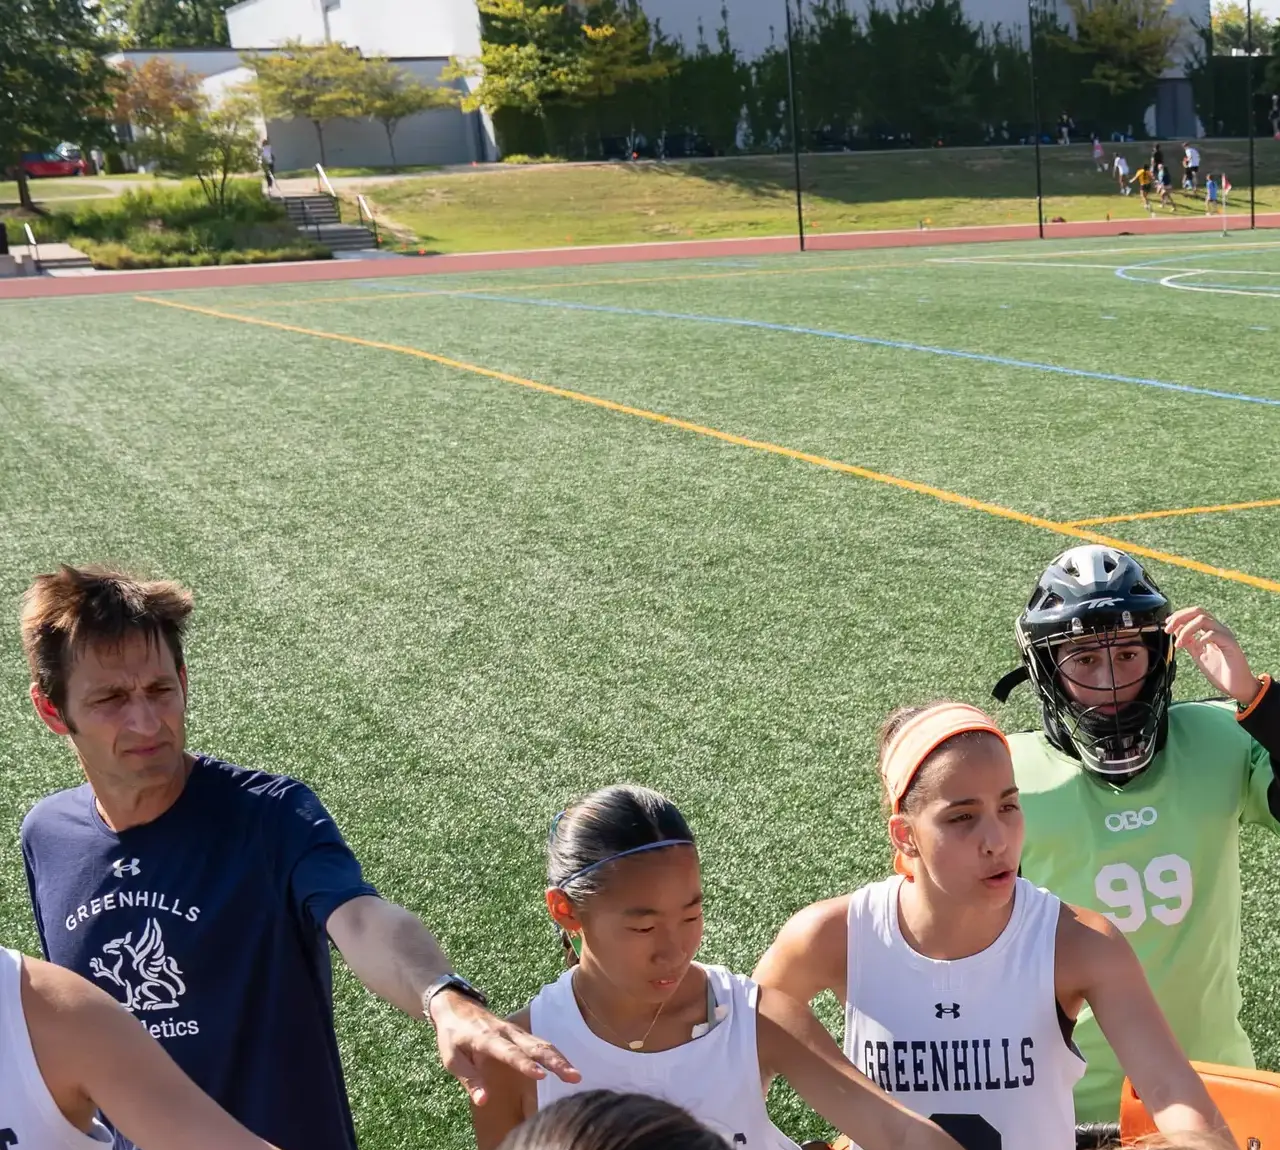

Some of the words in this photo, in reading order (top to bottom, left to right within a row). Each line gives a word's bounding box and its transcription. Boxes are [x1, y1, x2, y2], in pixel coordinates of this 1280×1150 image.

[1104, 806, 1158, 832] OBO
[66, 891, 200, 930] GREENHILLS
[1094, 854, 1193, 932] 99
[865, 1037, 1035, 1092] GREENHILLS
